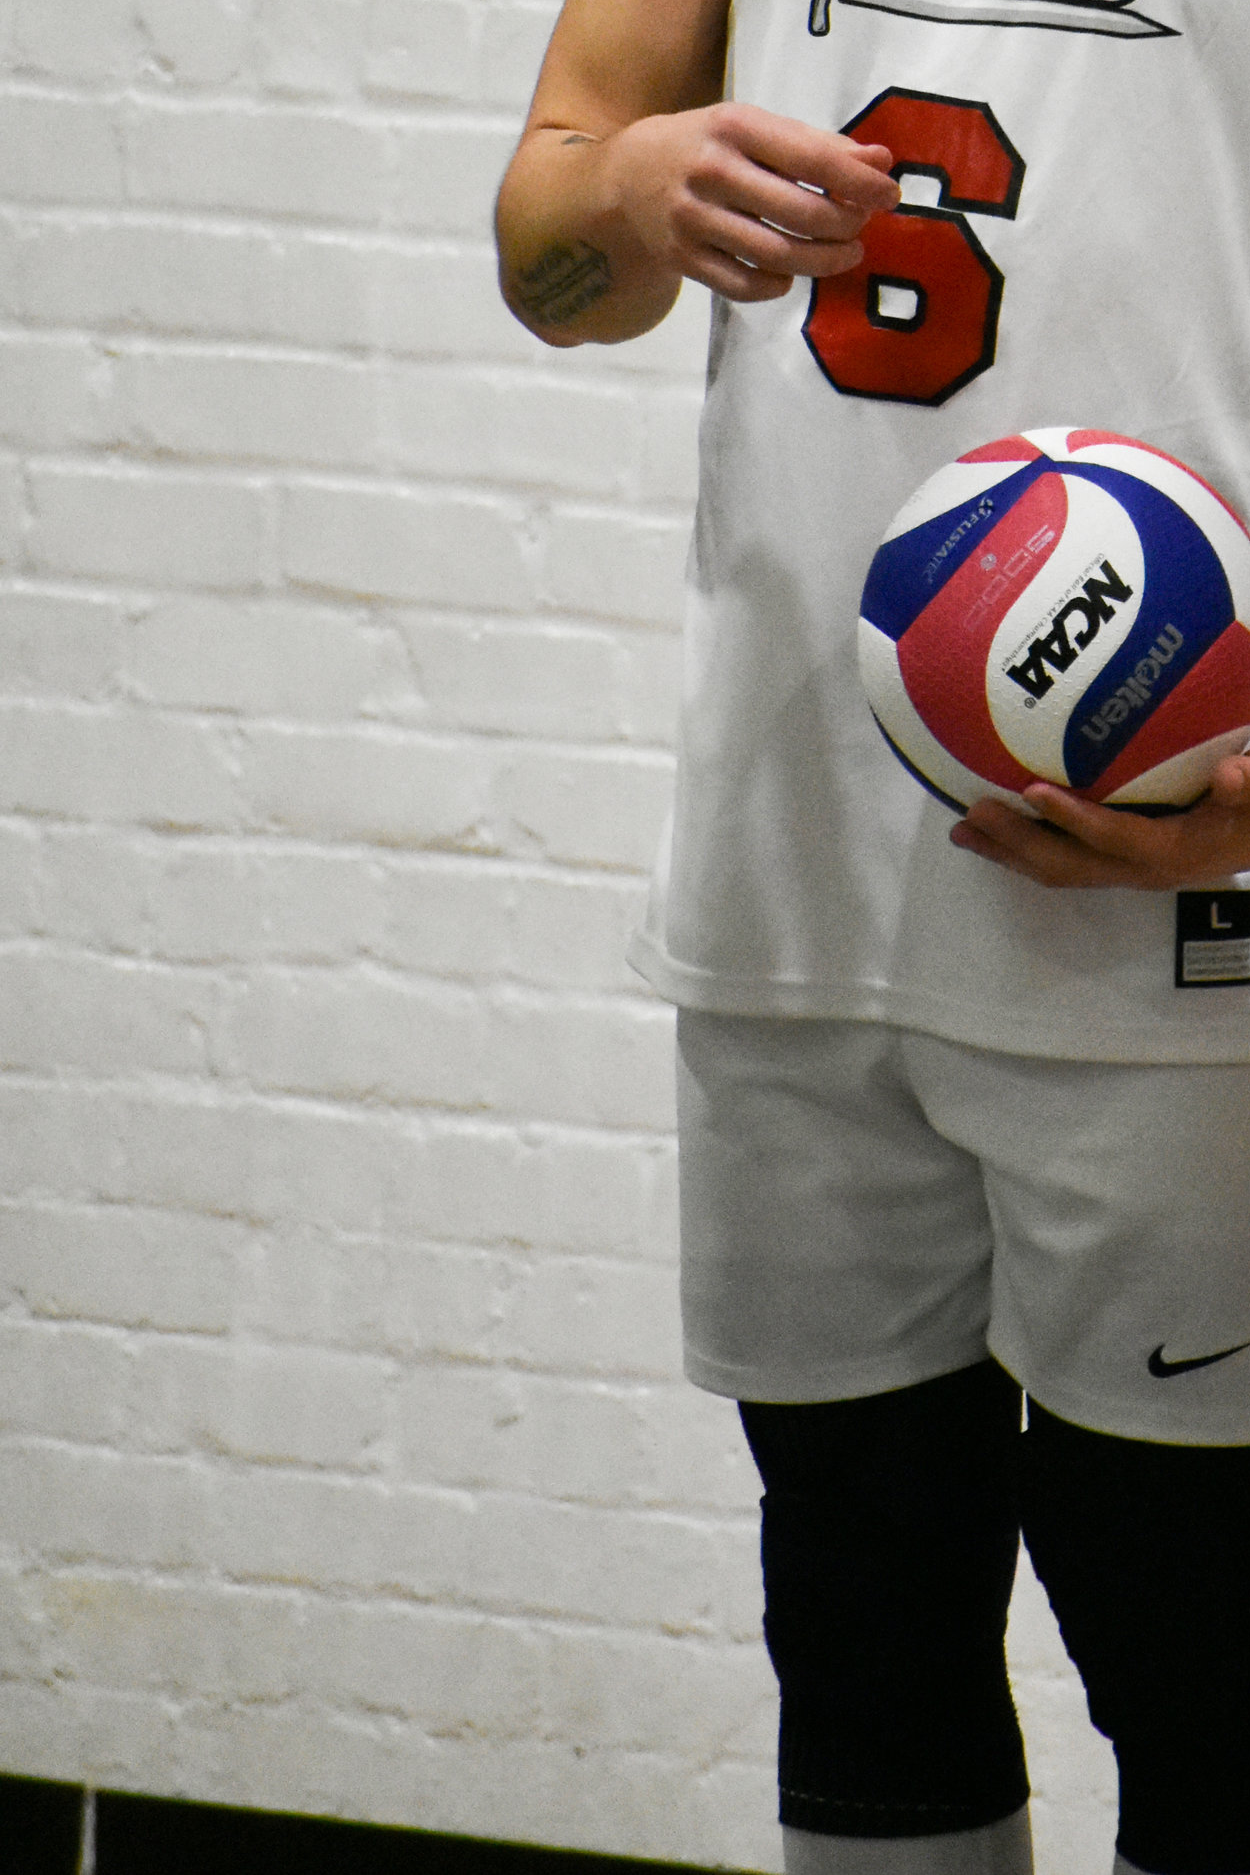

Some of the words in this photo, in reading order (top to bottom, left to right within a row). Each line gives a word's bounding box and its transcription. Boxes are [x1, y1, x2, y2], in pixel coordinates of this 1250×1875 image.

[801, 86, 1027, 408] 6
[1080, 623, 1185, 742] molten
[1211, 901, 1233, 929] L
